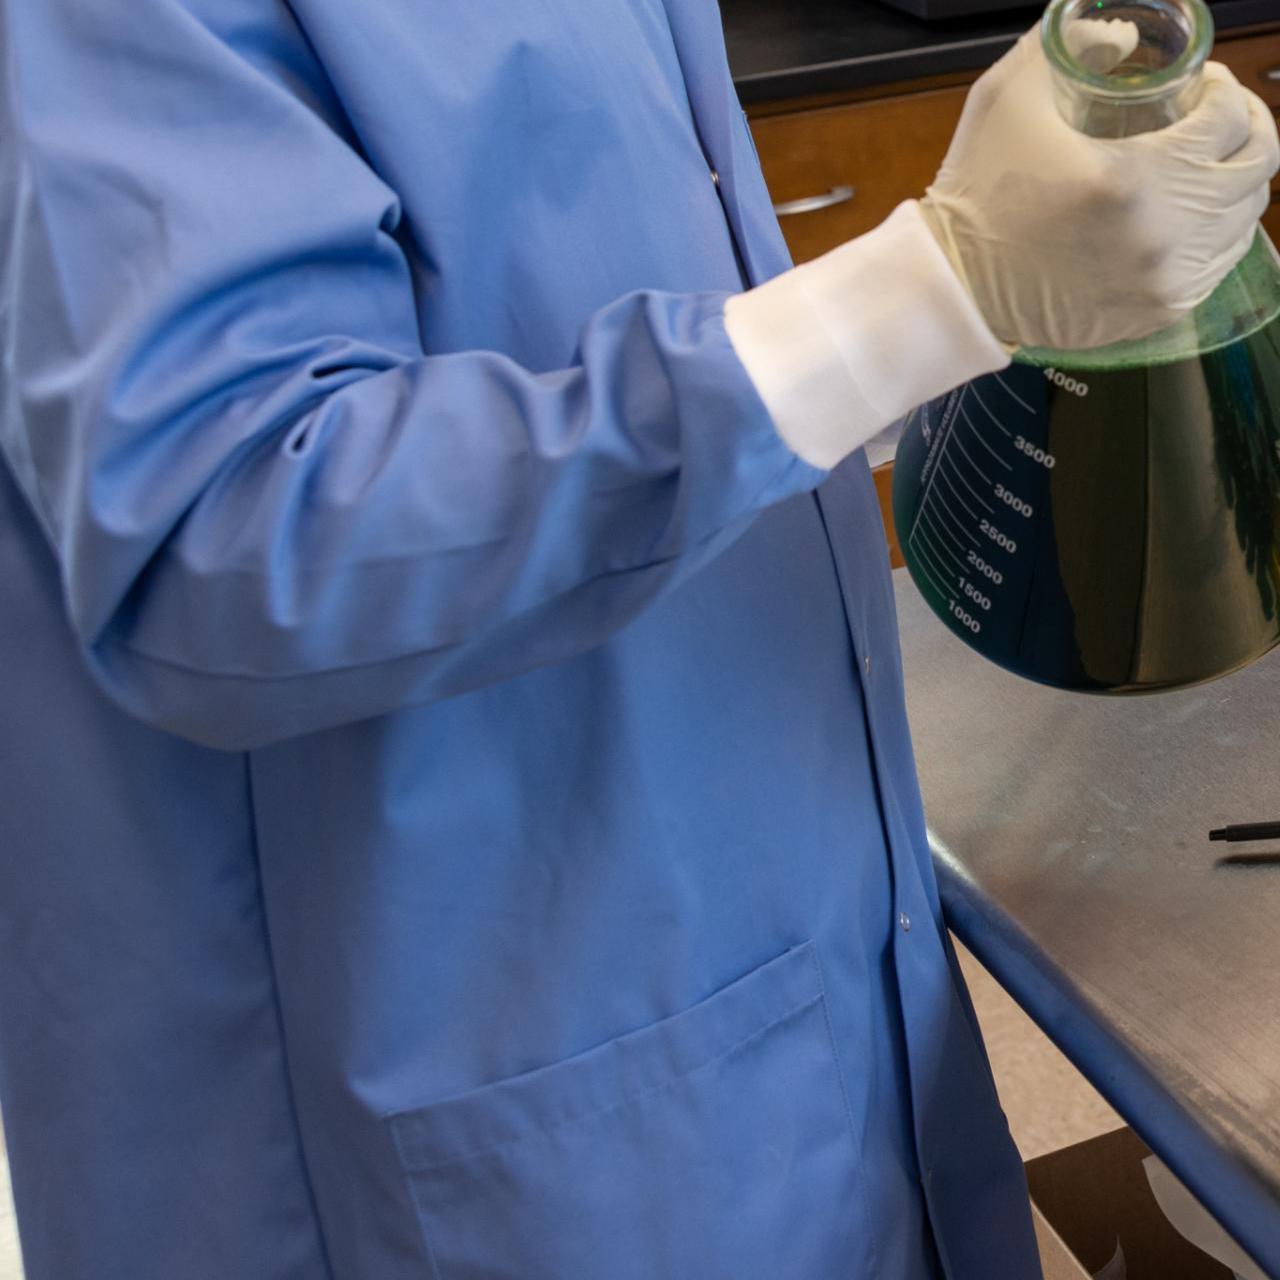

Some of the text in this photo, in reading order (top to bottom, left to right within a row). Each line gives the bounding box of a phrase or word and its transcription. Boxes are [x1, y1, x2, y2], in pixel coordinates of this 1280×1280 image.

[1043, 368, 1088, 397] 4000
[1014, 435, 1055, 470] 3500
[994, 483, 1033, 518] 3000
[979, 519, 1017, 554] 2500
[967, 550, 1003, 585] 2000
[957, 577, 992, 611] 1500
[948, 600, 981, 634] 1000
